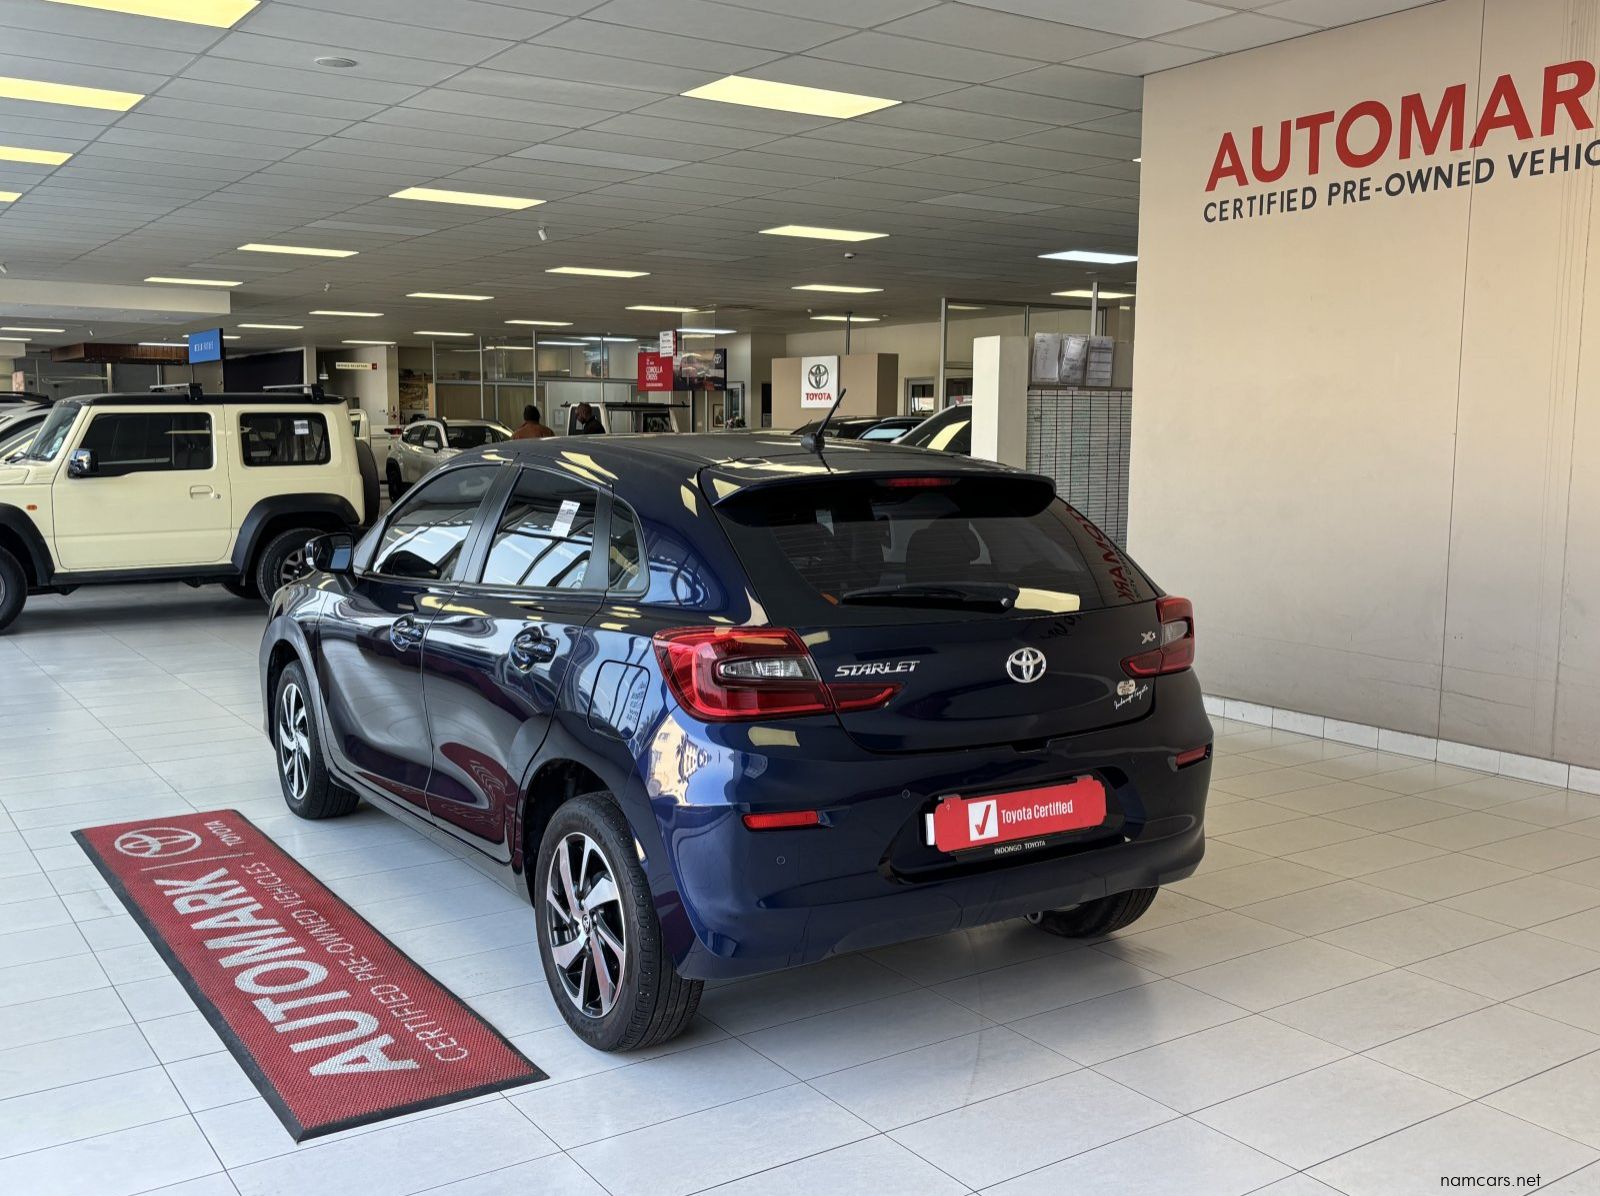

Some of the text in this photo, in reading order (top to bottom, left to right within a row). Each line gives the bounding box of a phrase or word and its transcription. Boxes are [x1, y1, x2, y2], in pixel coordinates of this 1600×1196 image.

[1205, 60, 1596, 192] AUTOMAR
[1203, 186, 1317, 223] CERTIFIED
[1327, 157, 1495, 206] PRE-OWNED
[805, 392, 832, 401] TOYOTA
[834, 660, 921, 678] STARLET
[1001, 800, 1074, 824] Toyota Certified
[204, 820, 245, 847] TOYOTA
[994, 840, 1046, 855] INDONGO TOYOTA
[153, 867, 420, 1076] AUTOMARK
[241, 861, 468, 1062] CERTIFIED PRE-OWNED VEHICLES
